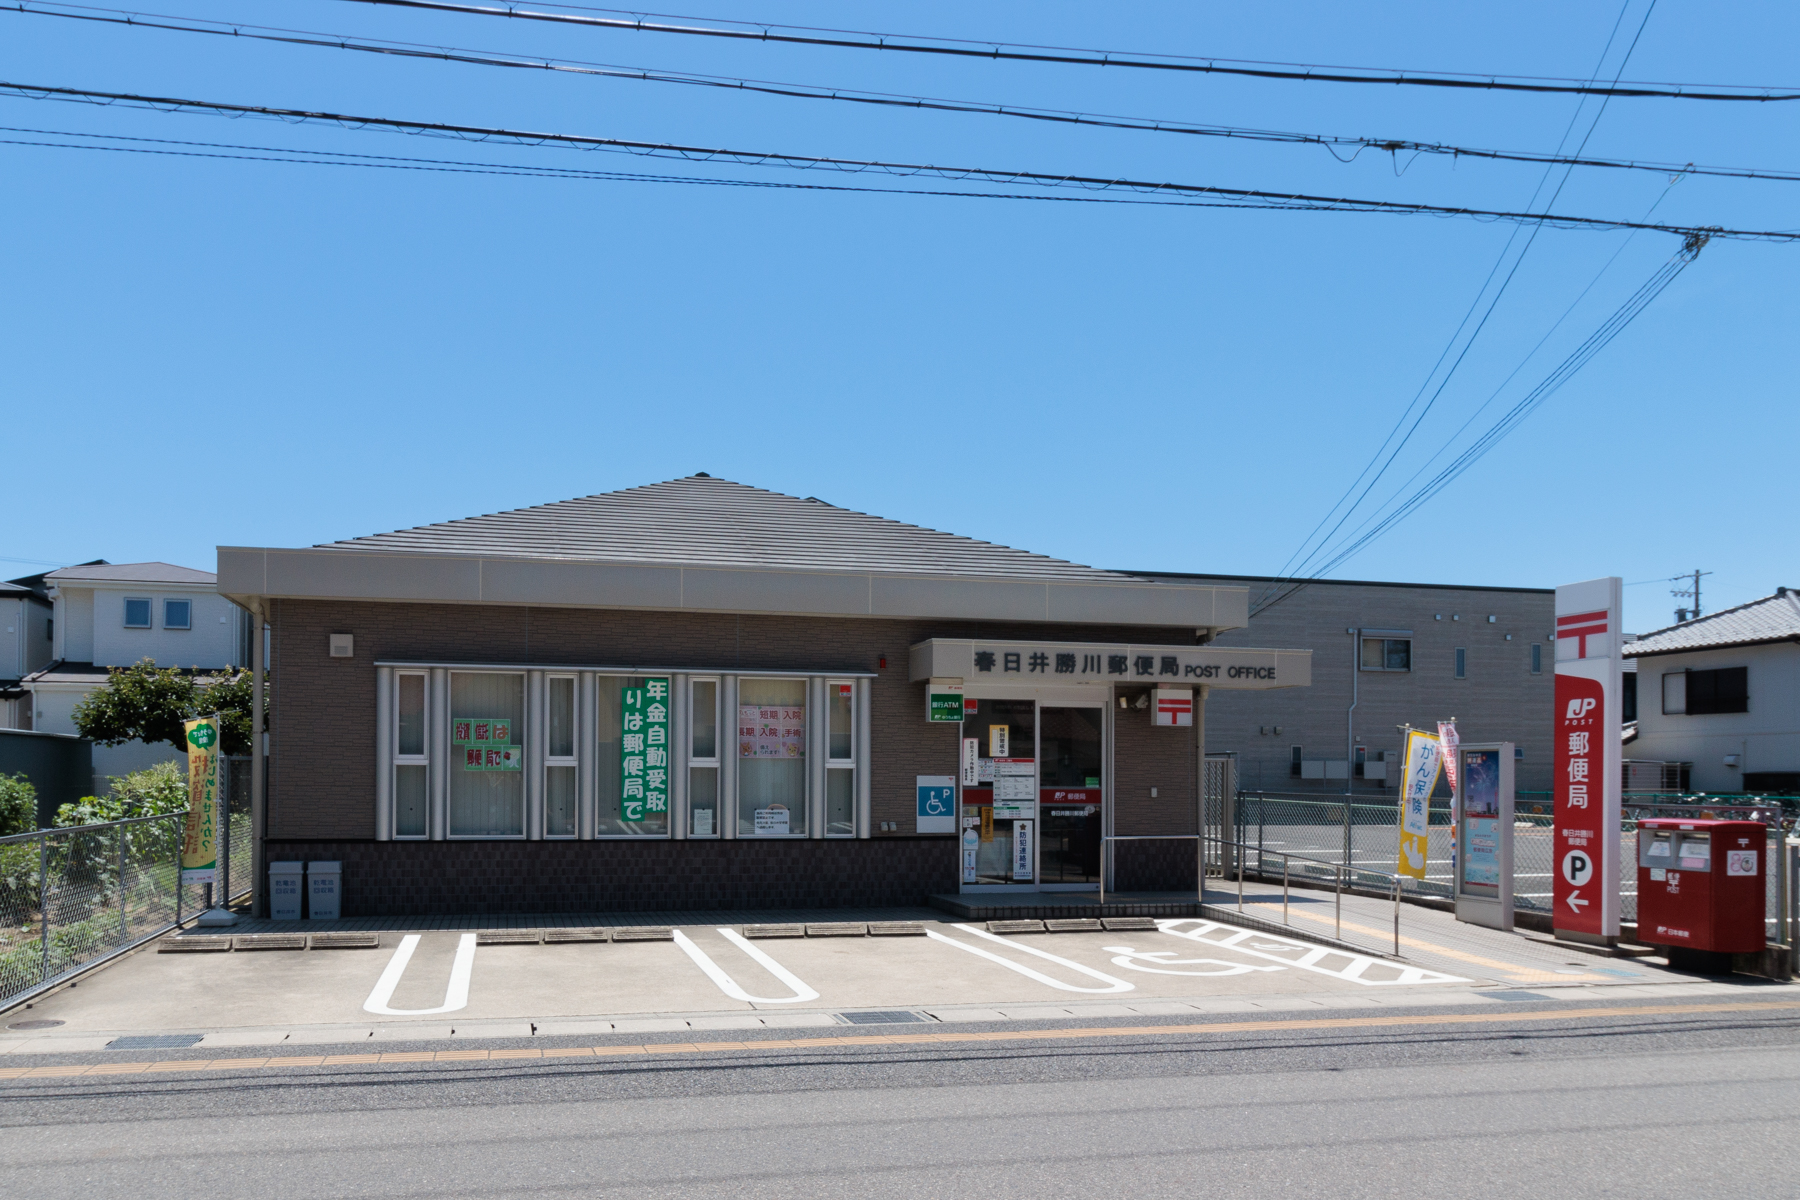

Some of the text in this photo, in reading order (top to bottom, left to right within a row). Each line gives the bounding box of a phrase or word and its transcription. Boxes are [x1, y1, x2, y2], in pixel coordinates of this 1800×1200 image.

[974, 651, 1276, 680] 春日井勝川郵便局 POST OFFICE
[931, 701, 959, 709] 銀行ATM
[783, 710, 802, 720] 入院
[1564, 718, 1594, 726] POST
[645, 680, 668, 812] 年金自動受取
[622, 689, 645, 820] りは郵便局で
[1567, 731, 1590, 809] 郵便局
[1411, 743, 1435, 816] がん保険
[943, 788, 951, 799] P
[1067, 792, 1086, 800] 郵便局
[1562, 828, 1594, 838] 春日井勝川
[1568, 837, 1588, 846] 郵便局
[1018, 831, 1027, 871] 防犯連絡所
[1570, 855, 1587, 881] P
[1666, 885, 1680, 894] POST
